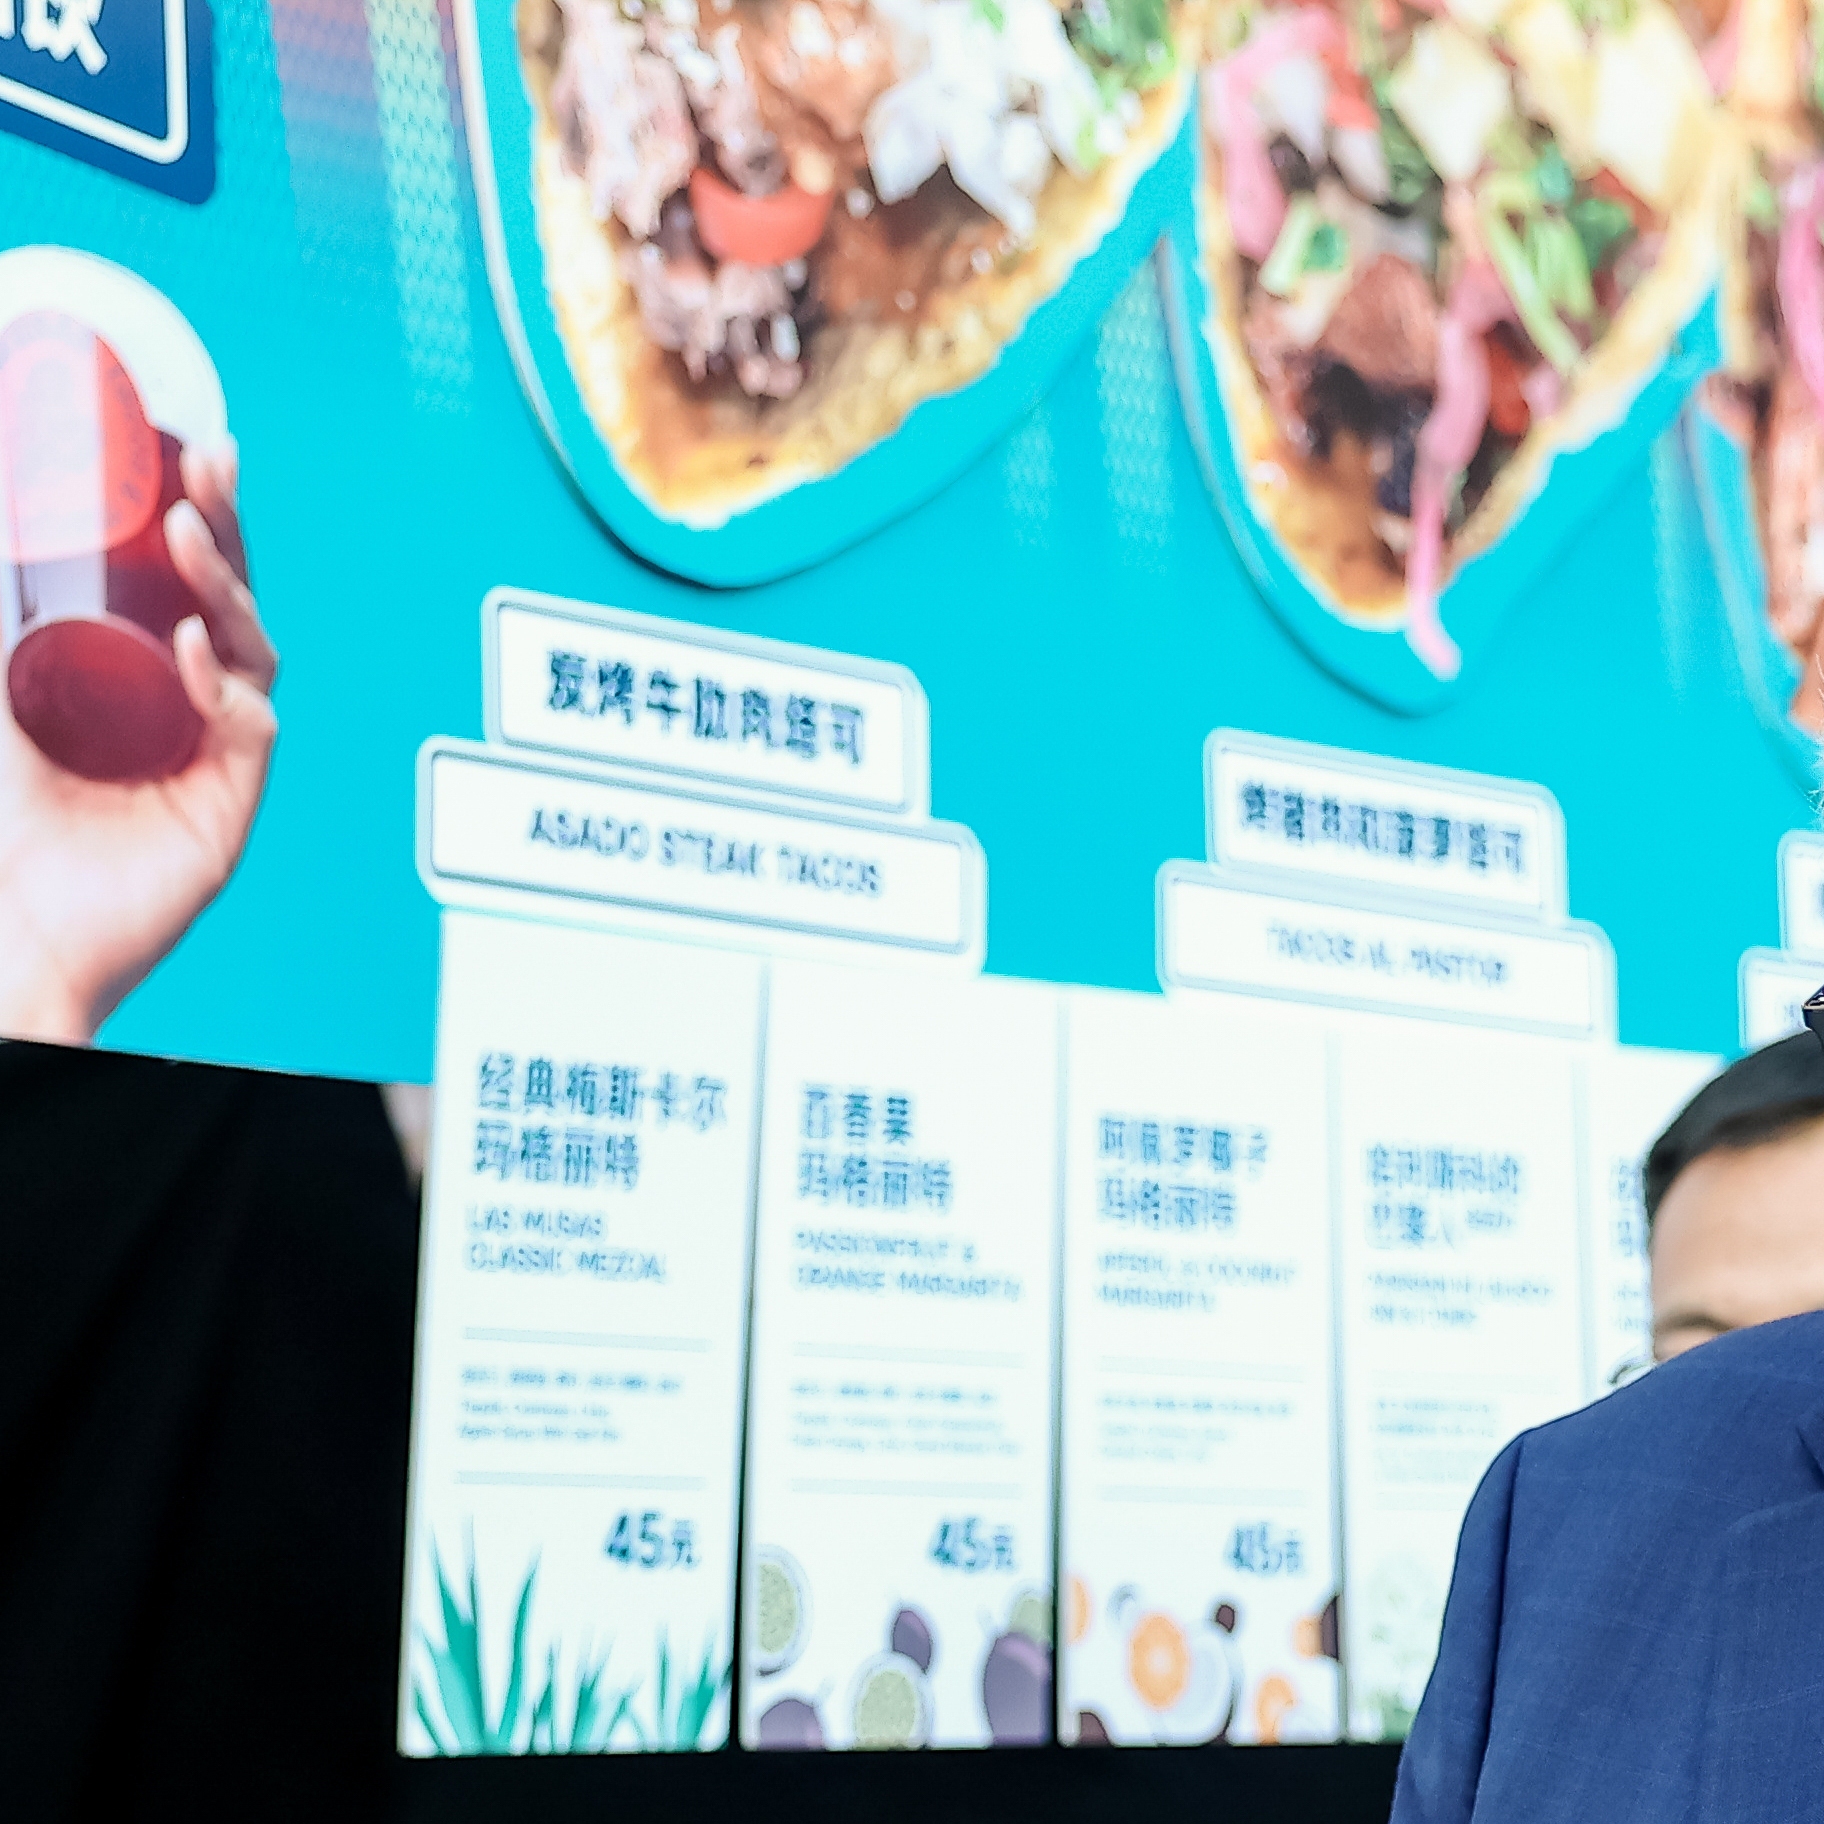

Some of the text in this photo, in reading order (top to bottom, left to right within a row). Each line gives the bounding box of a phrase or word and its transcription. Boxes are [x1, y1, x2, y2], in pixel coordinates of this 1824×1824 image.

[530, 806, 887, 898] ASADO STEAK TACOS
[800, 1082, 915, 1145] 百香果
[473, 1120, 641, 1190] 玛格丽特
[466, 1204, 606, 1241] LAS MUSAS
[467, 1240, 570, 1276] CLASSIC
[601, 1508, 702, 1571] 45元
[927, 1516, 1021, 1573] 45元
